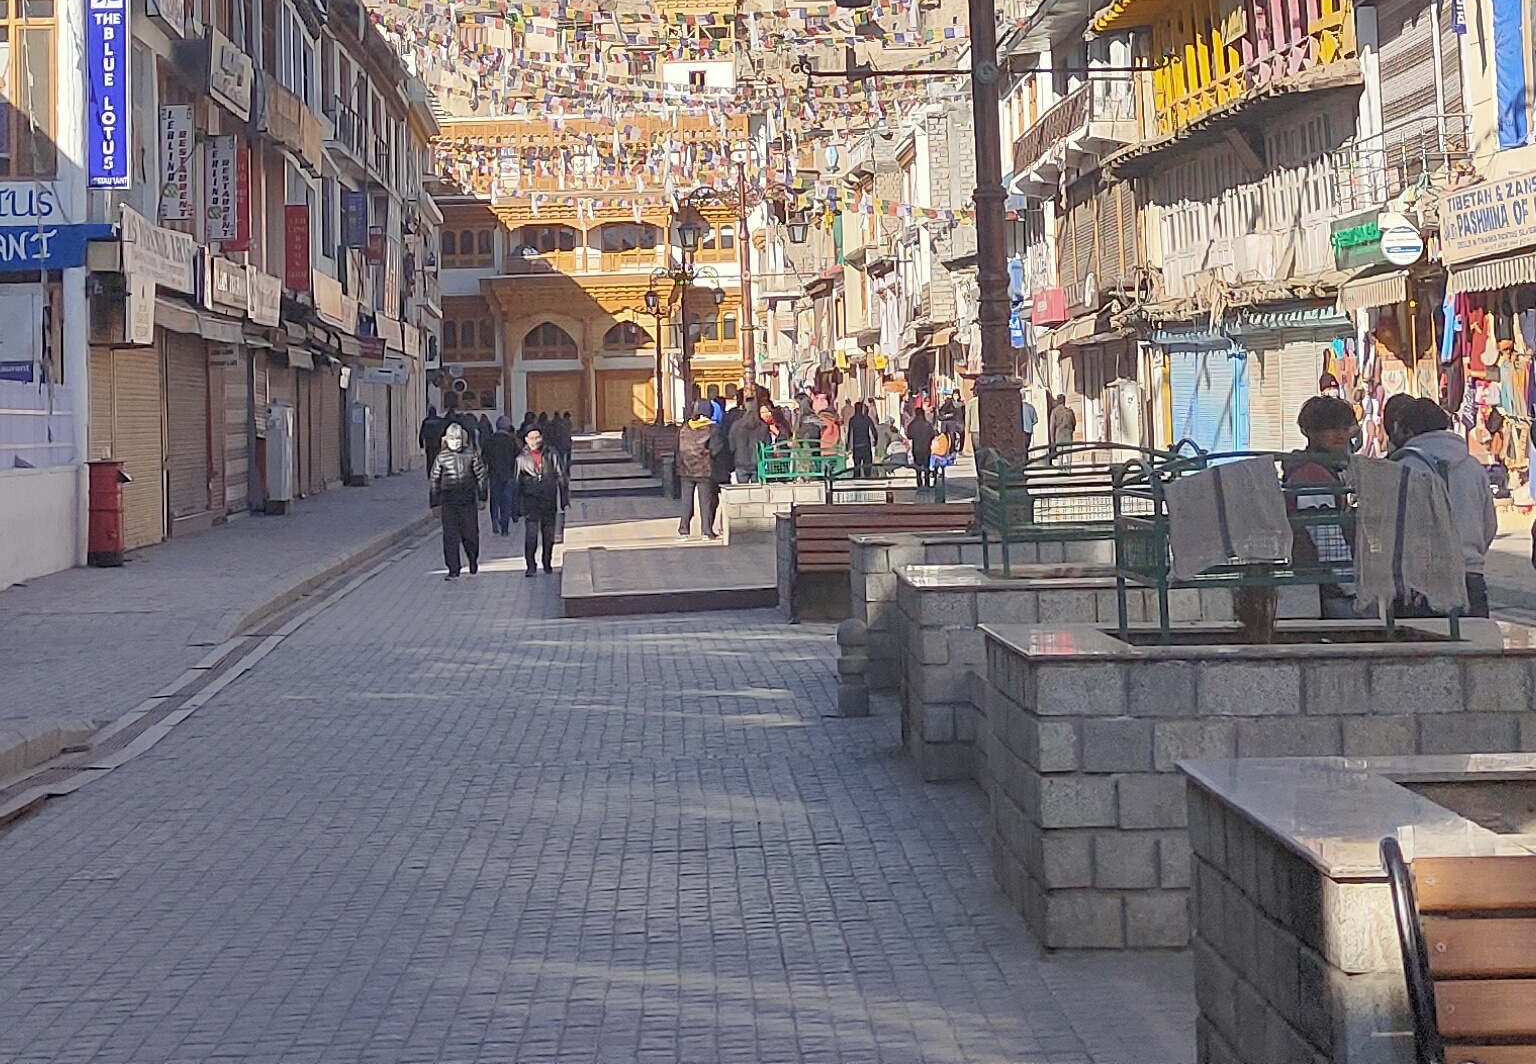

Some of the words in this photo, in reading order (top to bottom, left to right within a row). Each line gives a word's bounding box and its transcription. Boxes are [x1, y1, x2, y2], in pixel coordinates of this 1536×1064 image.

[94, 12, 123, 26] THE
[102, 26, 116, 87] BLUE
[100, 95, 117, 170] LOTUS
[1446, 187, 1493, 214] TIBETAN
[1495, 185, 1504, 202] &
[1456, 203, 1511, 239] PASHMINA
[1512, 197, 1530, 226] OF
